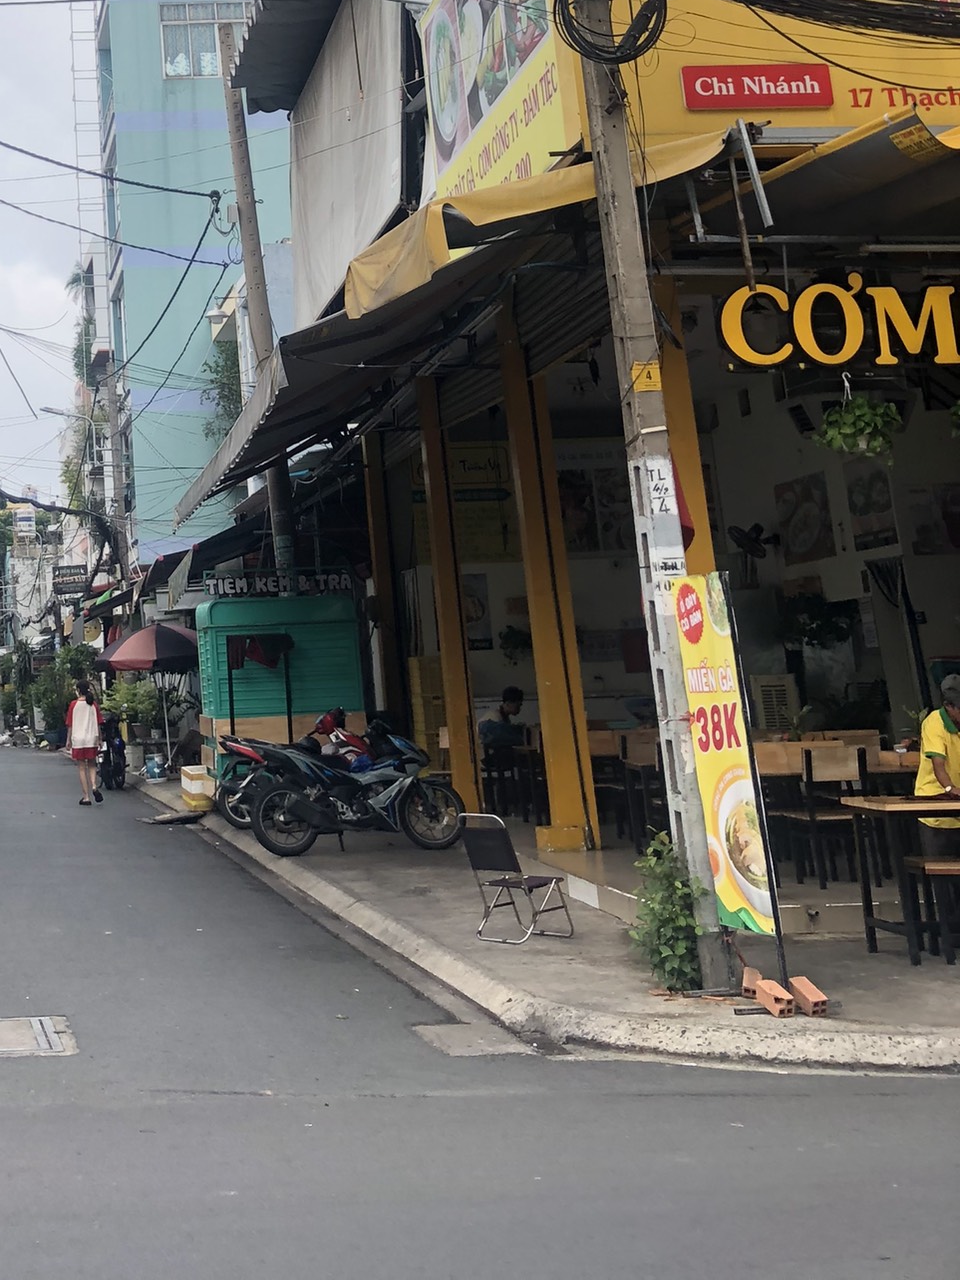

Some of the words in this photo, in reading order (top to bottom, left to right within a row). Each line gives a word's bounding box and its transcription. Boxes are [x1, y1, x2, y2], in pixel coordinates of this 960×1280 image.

[695, 77, 735, 96] Chi
[742, 75, 820, 96] Nhánh
[848, 88, 873, 108] 17
[721, 272, 960, 365] CƠM
[646, 370, 652, 380] 4
[255, 576, 292, 593] KEM
[298, 575, 311, 591] &
[315, 570, 352, 591] TRÀ
[686, 657, 717, 693] MIẾN
[718, 659, 736, 692] GÀ
[695, 702, 742, 753] 38K
